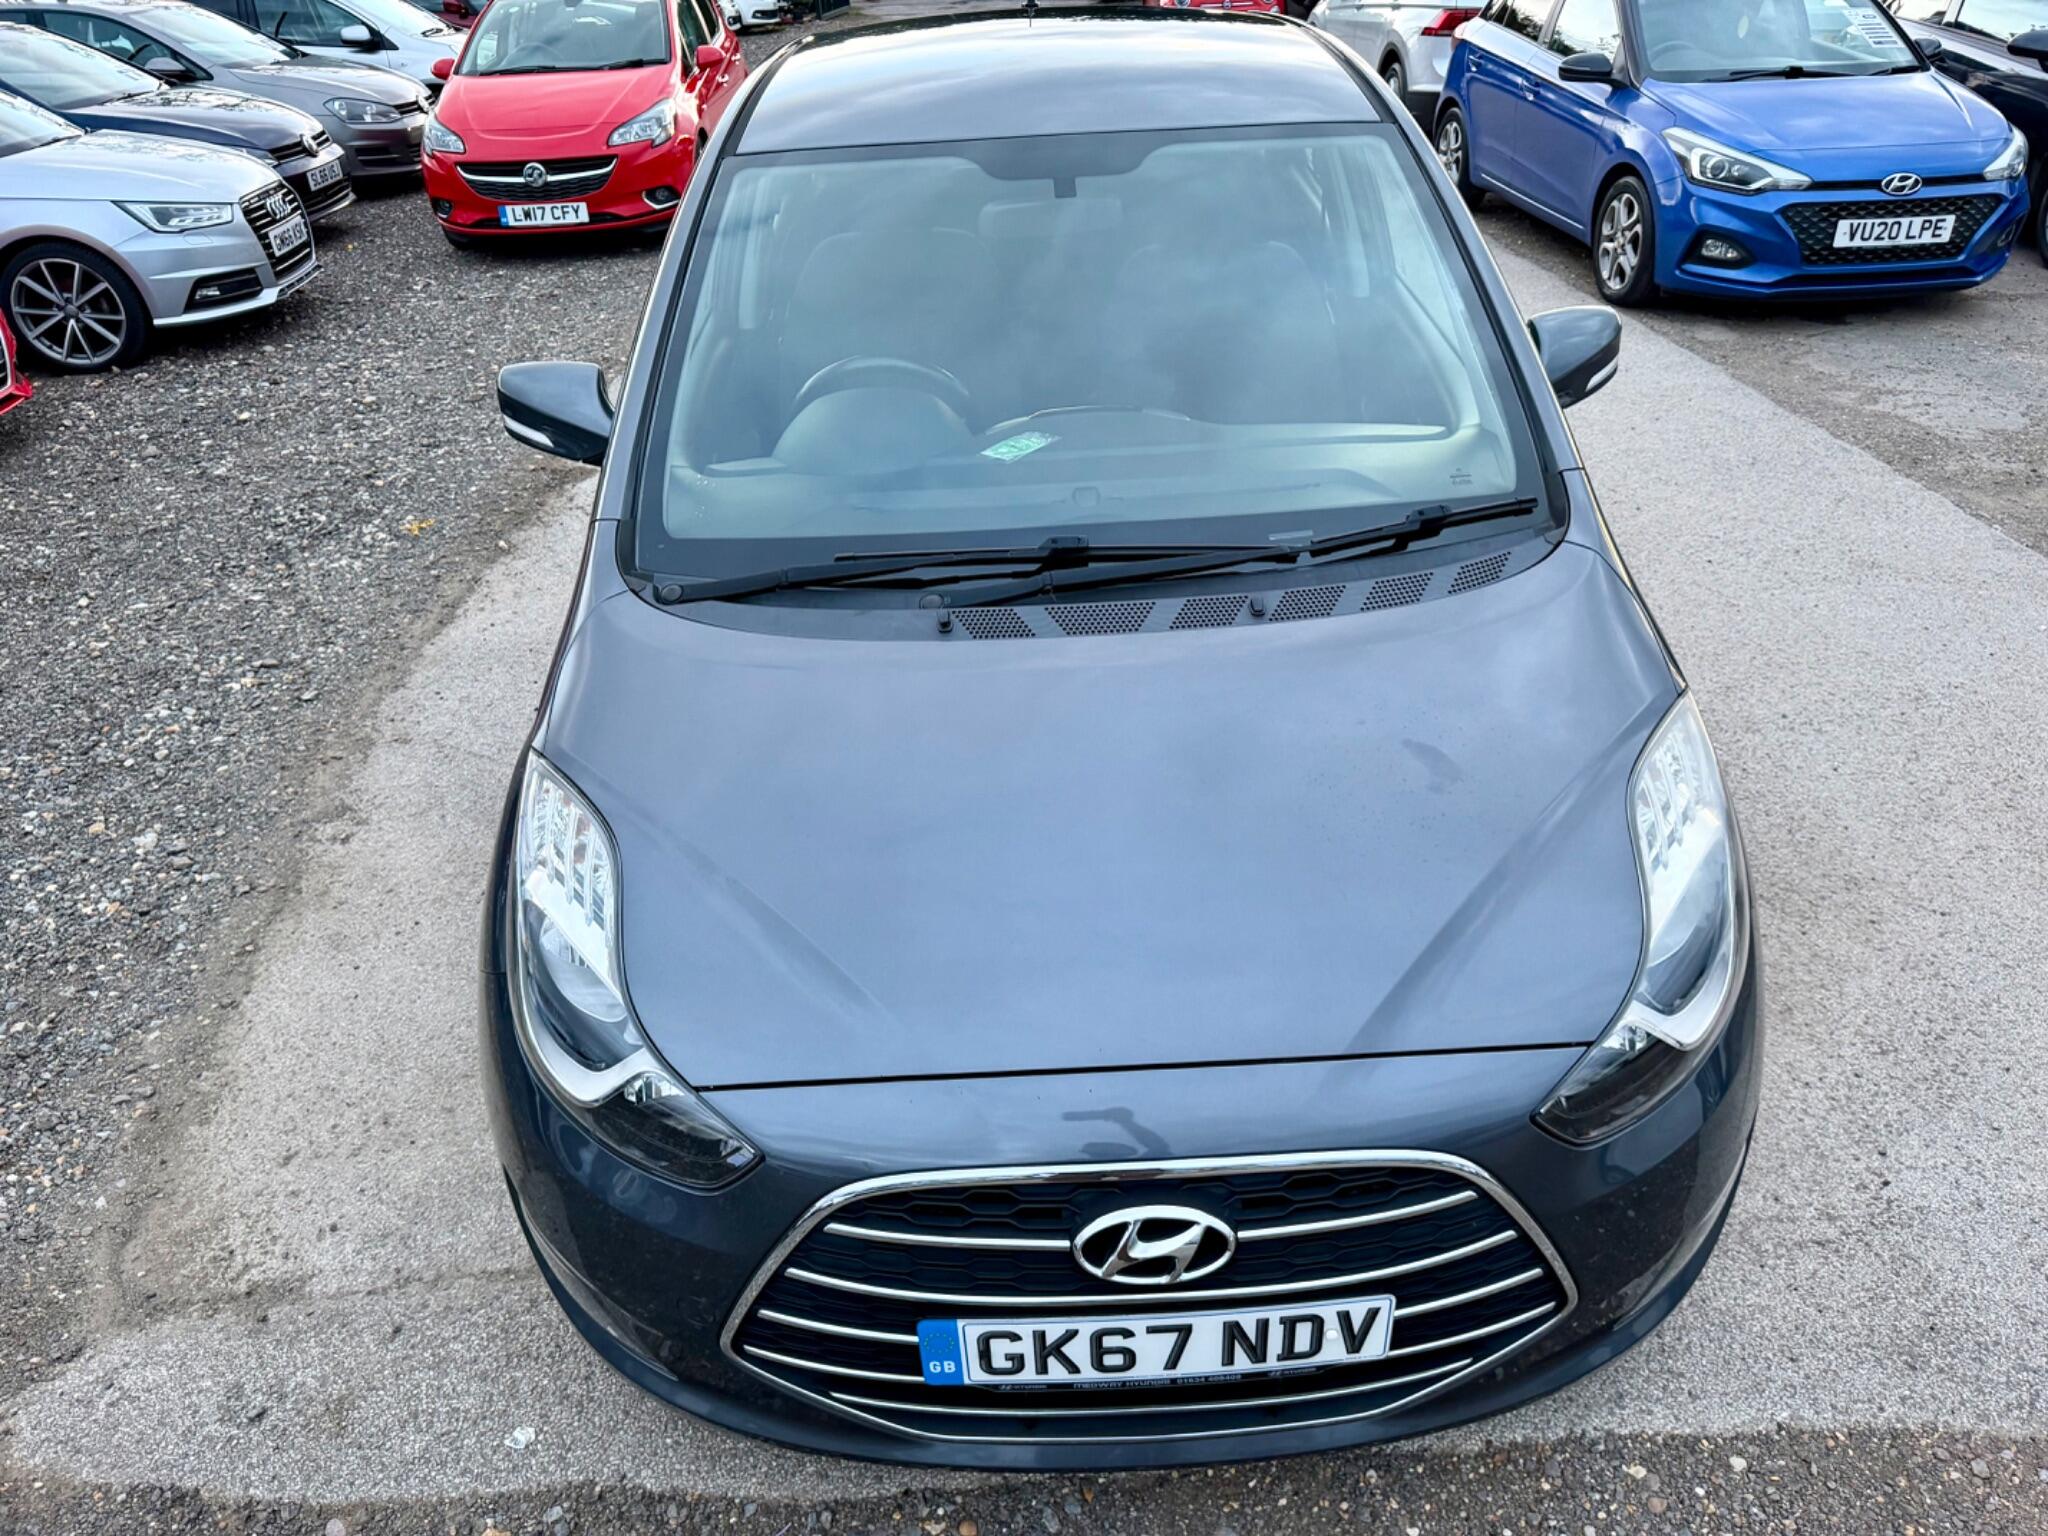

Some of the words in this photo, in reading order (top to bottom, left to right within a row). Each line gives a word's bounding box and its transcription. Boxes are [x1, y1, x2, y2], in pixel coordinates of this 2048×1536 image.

[511, 206, 546, 222] LW17
[550, 204, 580, 220] CFY
[1849, 221, 1902, 242] VU20
[1905, 218, 1947, 240] LPE
[976, 1323, 1193, 1375] GK67
[1221, 1307, 1382, 1366] NDV
[929, 1360, 956, 1373] GB
